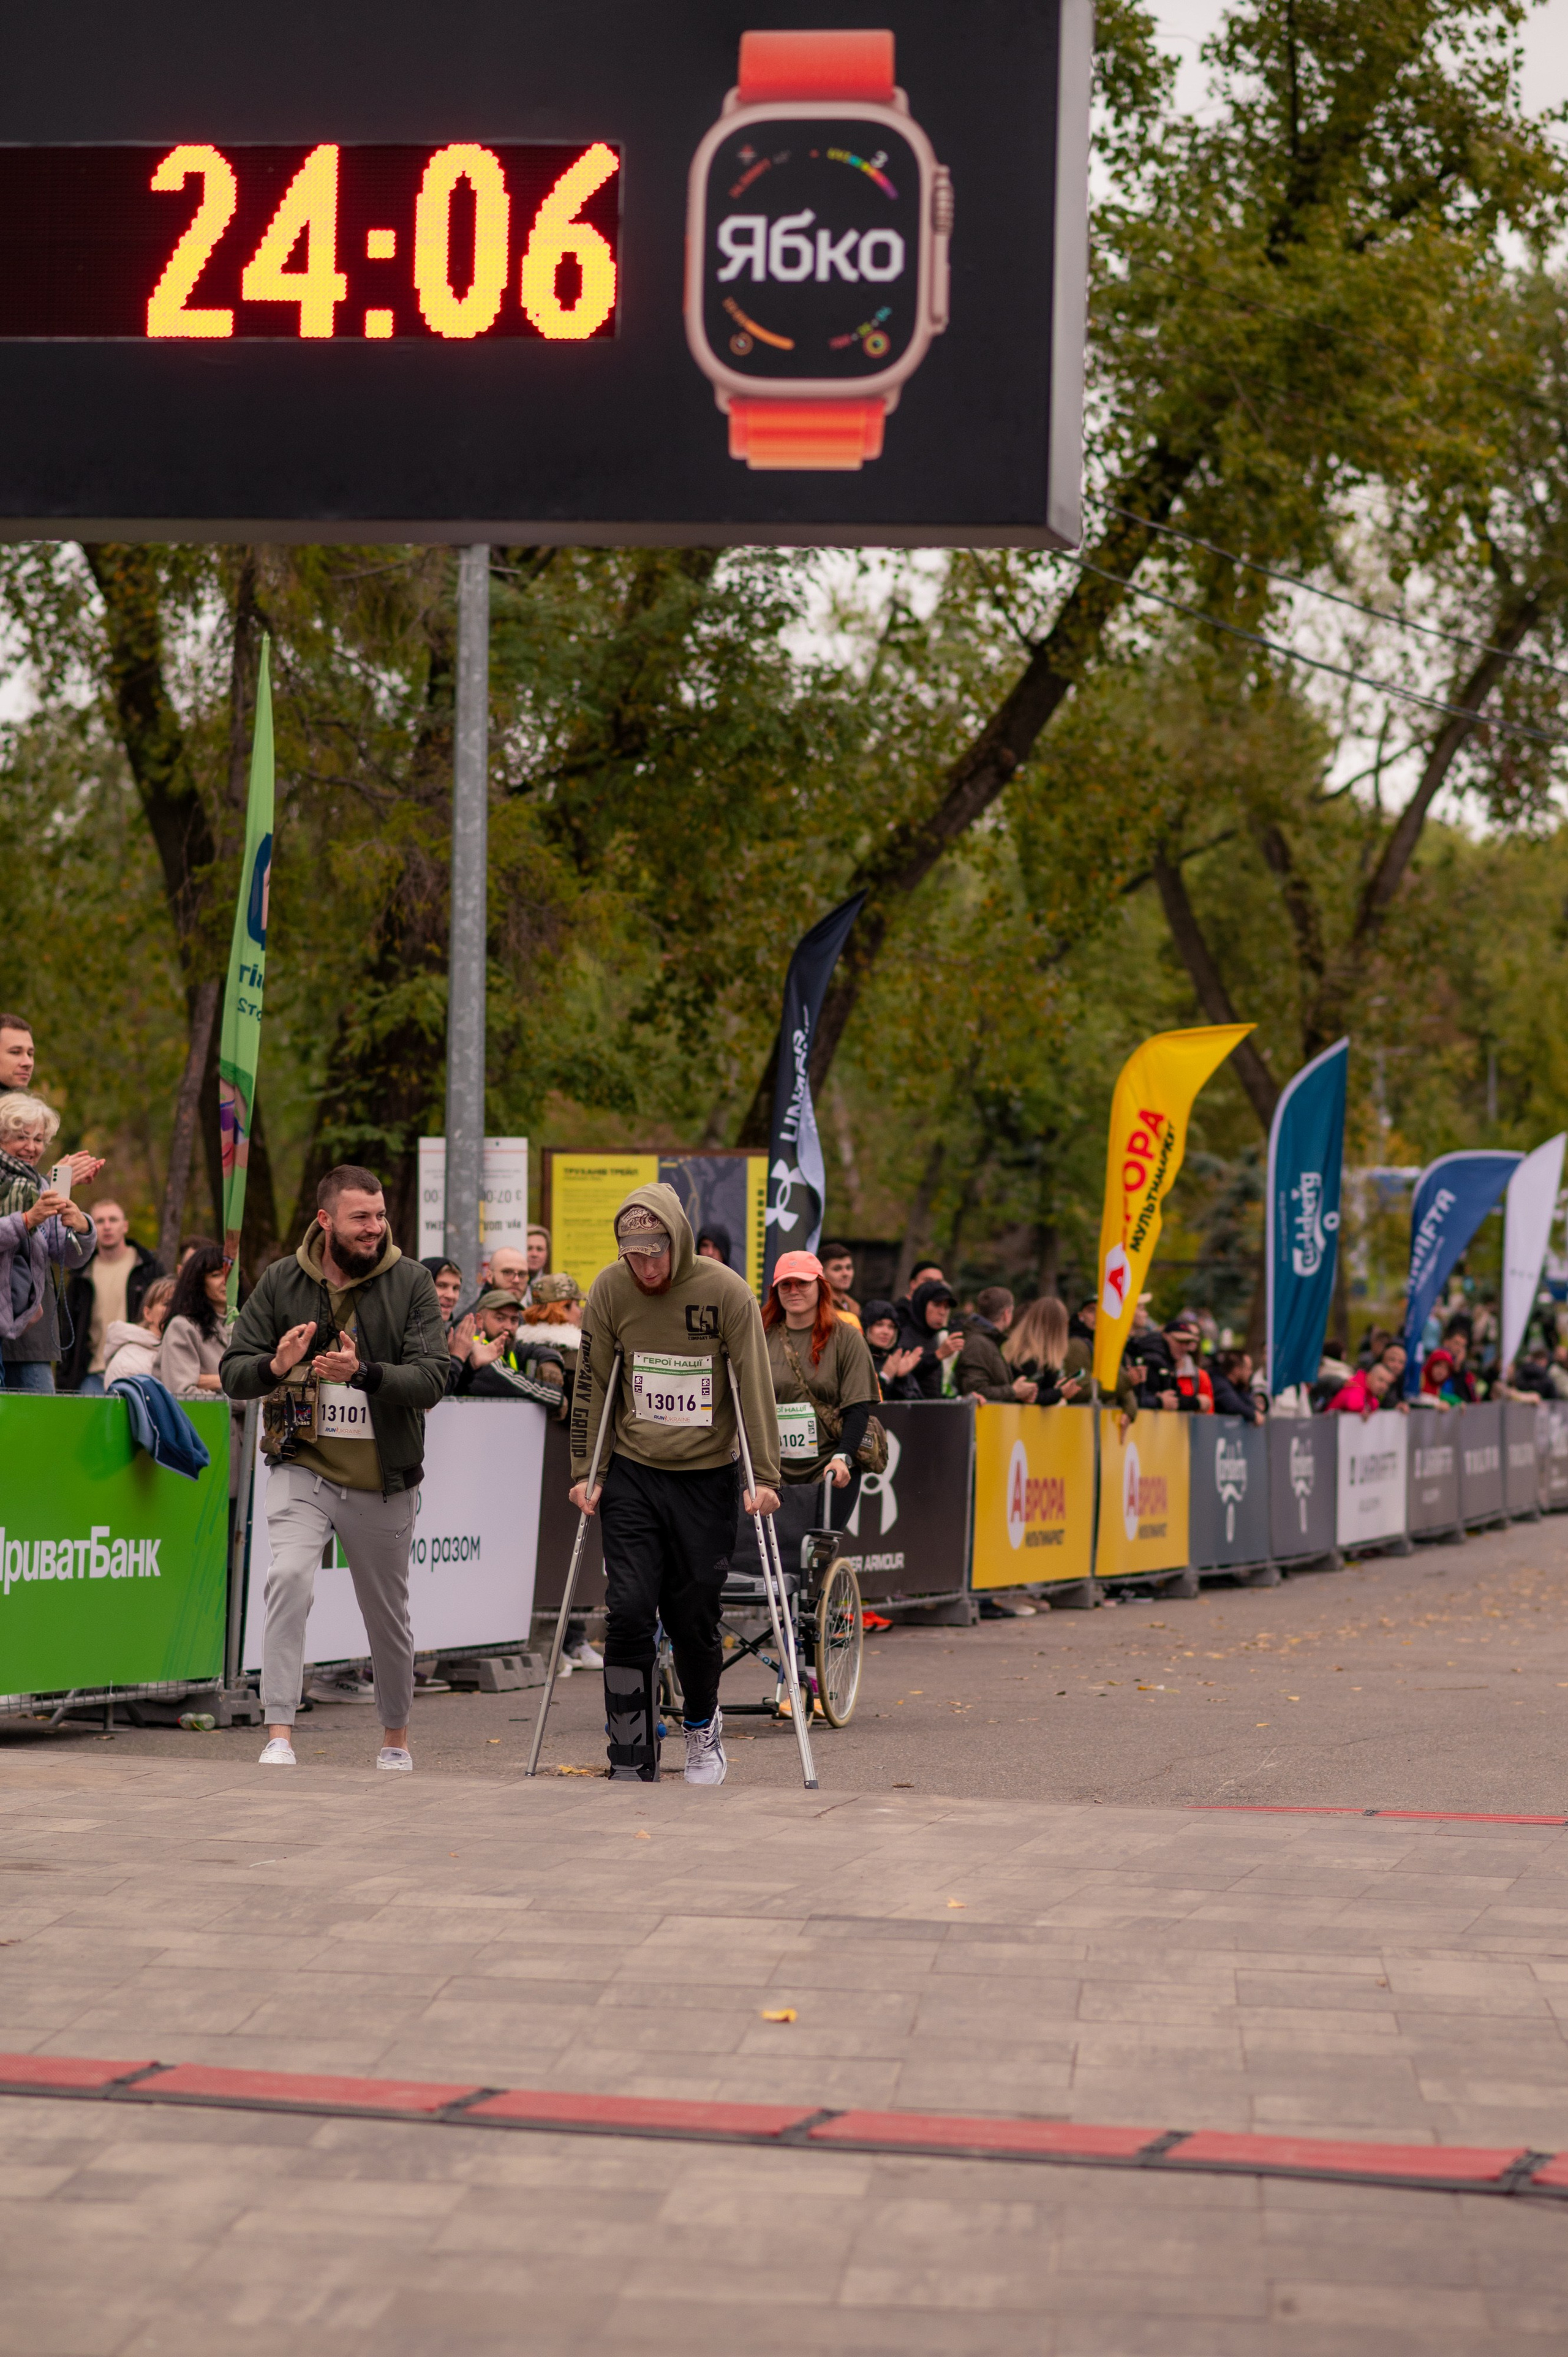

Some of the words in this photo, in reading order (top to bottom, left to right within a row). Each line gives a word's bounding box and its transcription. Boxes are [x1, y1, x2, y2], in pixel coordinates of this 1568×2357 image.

[146, 143, 619, 339] 24:06
[643, 1356, 672, 1366] ГЕРОЇ
[674, 1359, 703, 1368] НАЦІЇ
[646, 1392, 696, 1412] 13016
[322, 1403, 367, 1424] 13101
[570, 1407, 590, 1458] GROUP
[780, 1433, 805, 1447] 102
[431, 1535, 481, 1572] разом
[864, 1551, 905, 1573] ARMOUR
